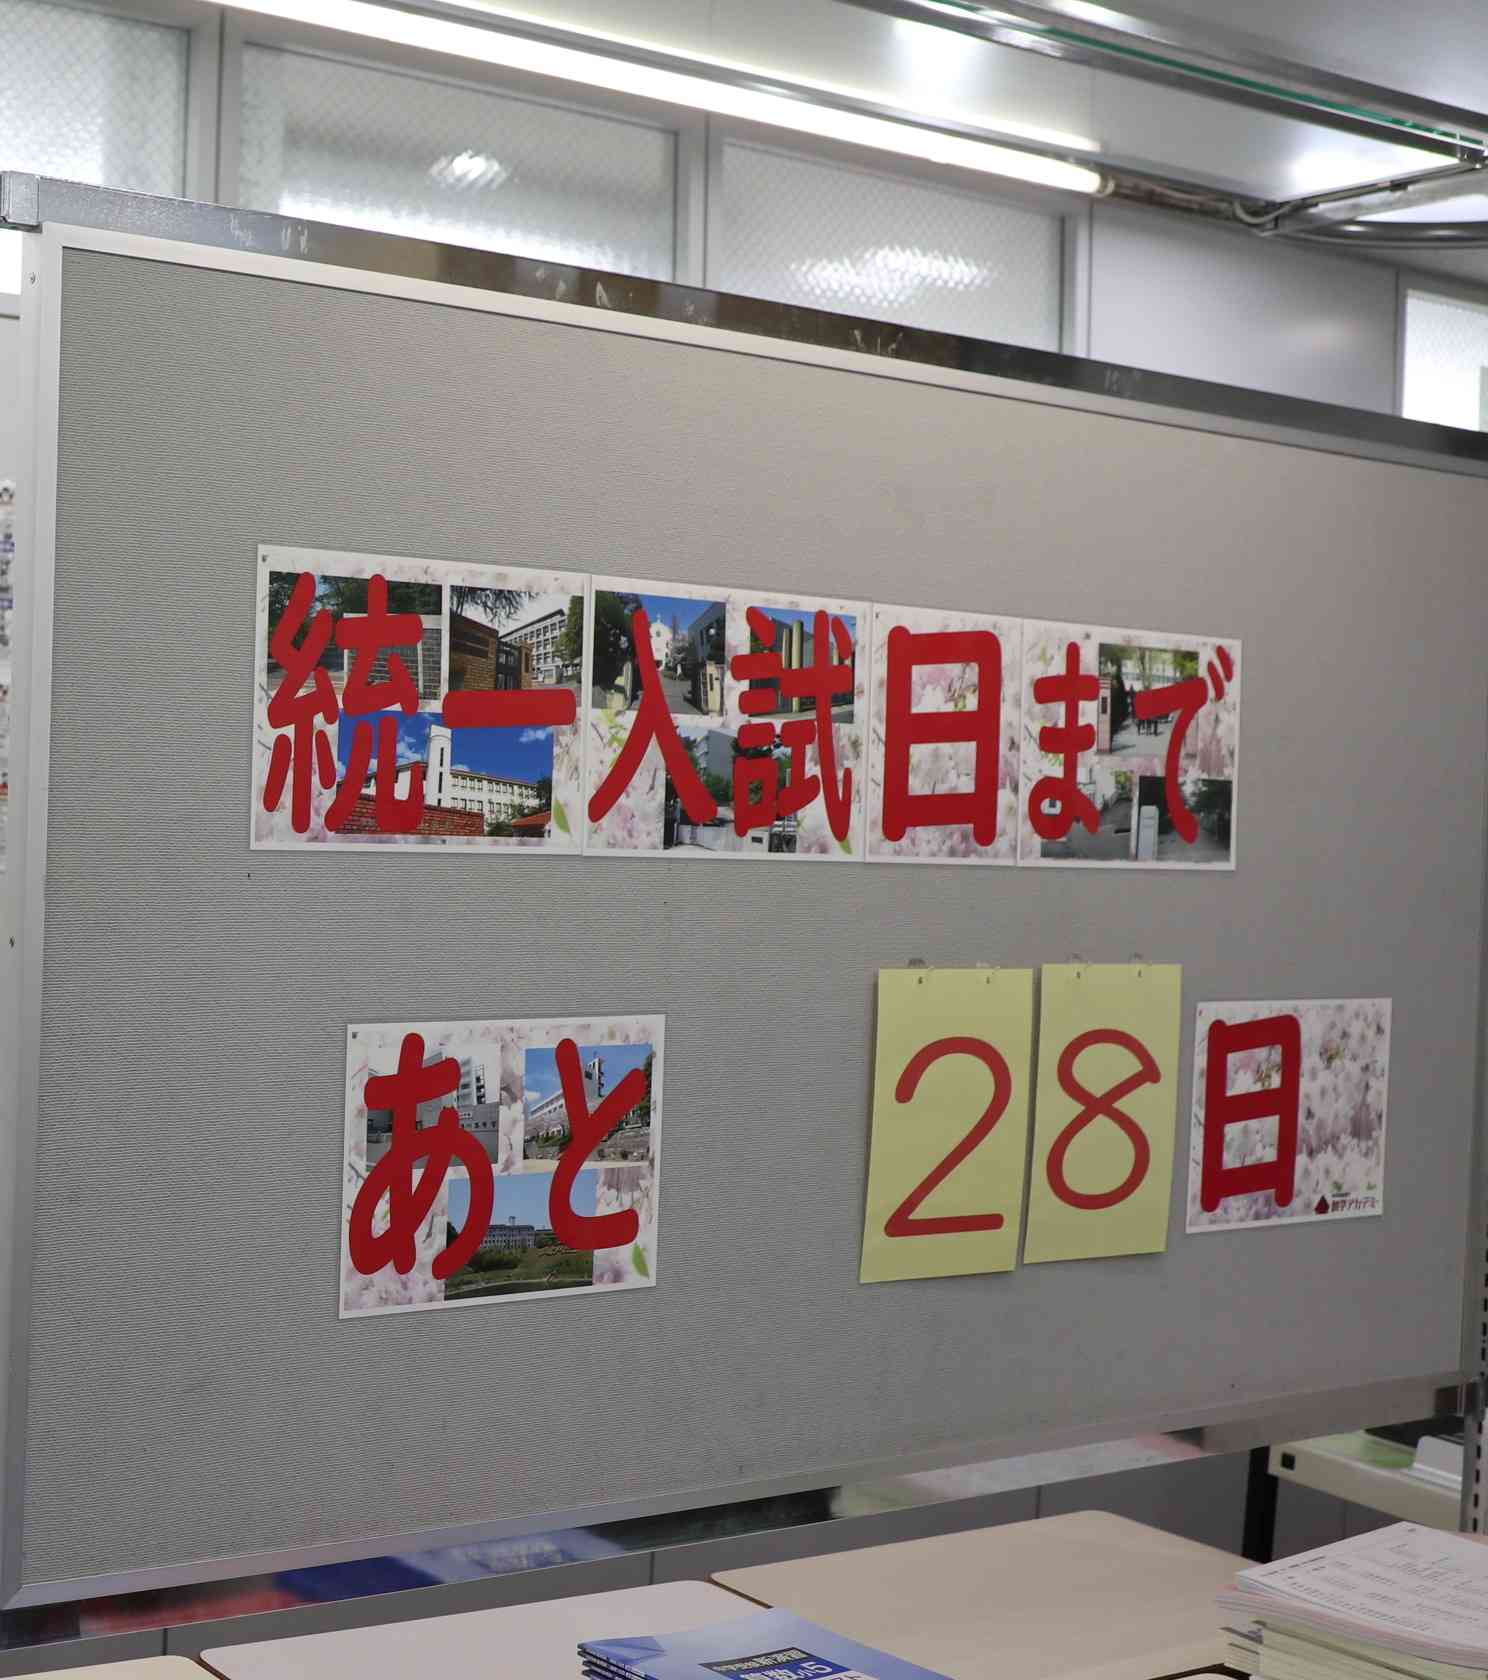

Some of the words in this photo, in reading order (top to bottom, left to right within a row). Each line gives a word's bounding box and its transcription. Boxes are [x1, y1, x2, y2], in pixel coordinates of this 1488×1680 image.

[262, 571, 1238, 847] 統一入試日まで
[348, 1031, 648, 1280] あと
[1198, 1012, 1301, 1214] 日
